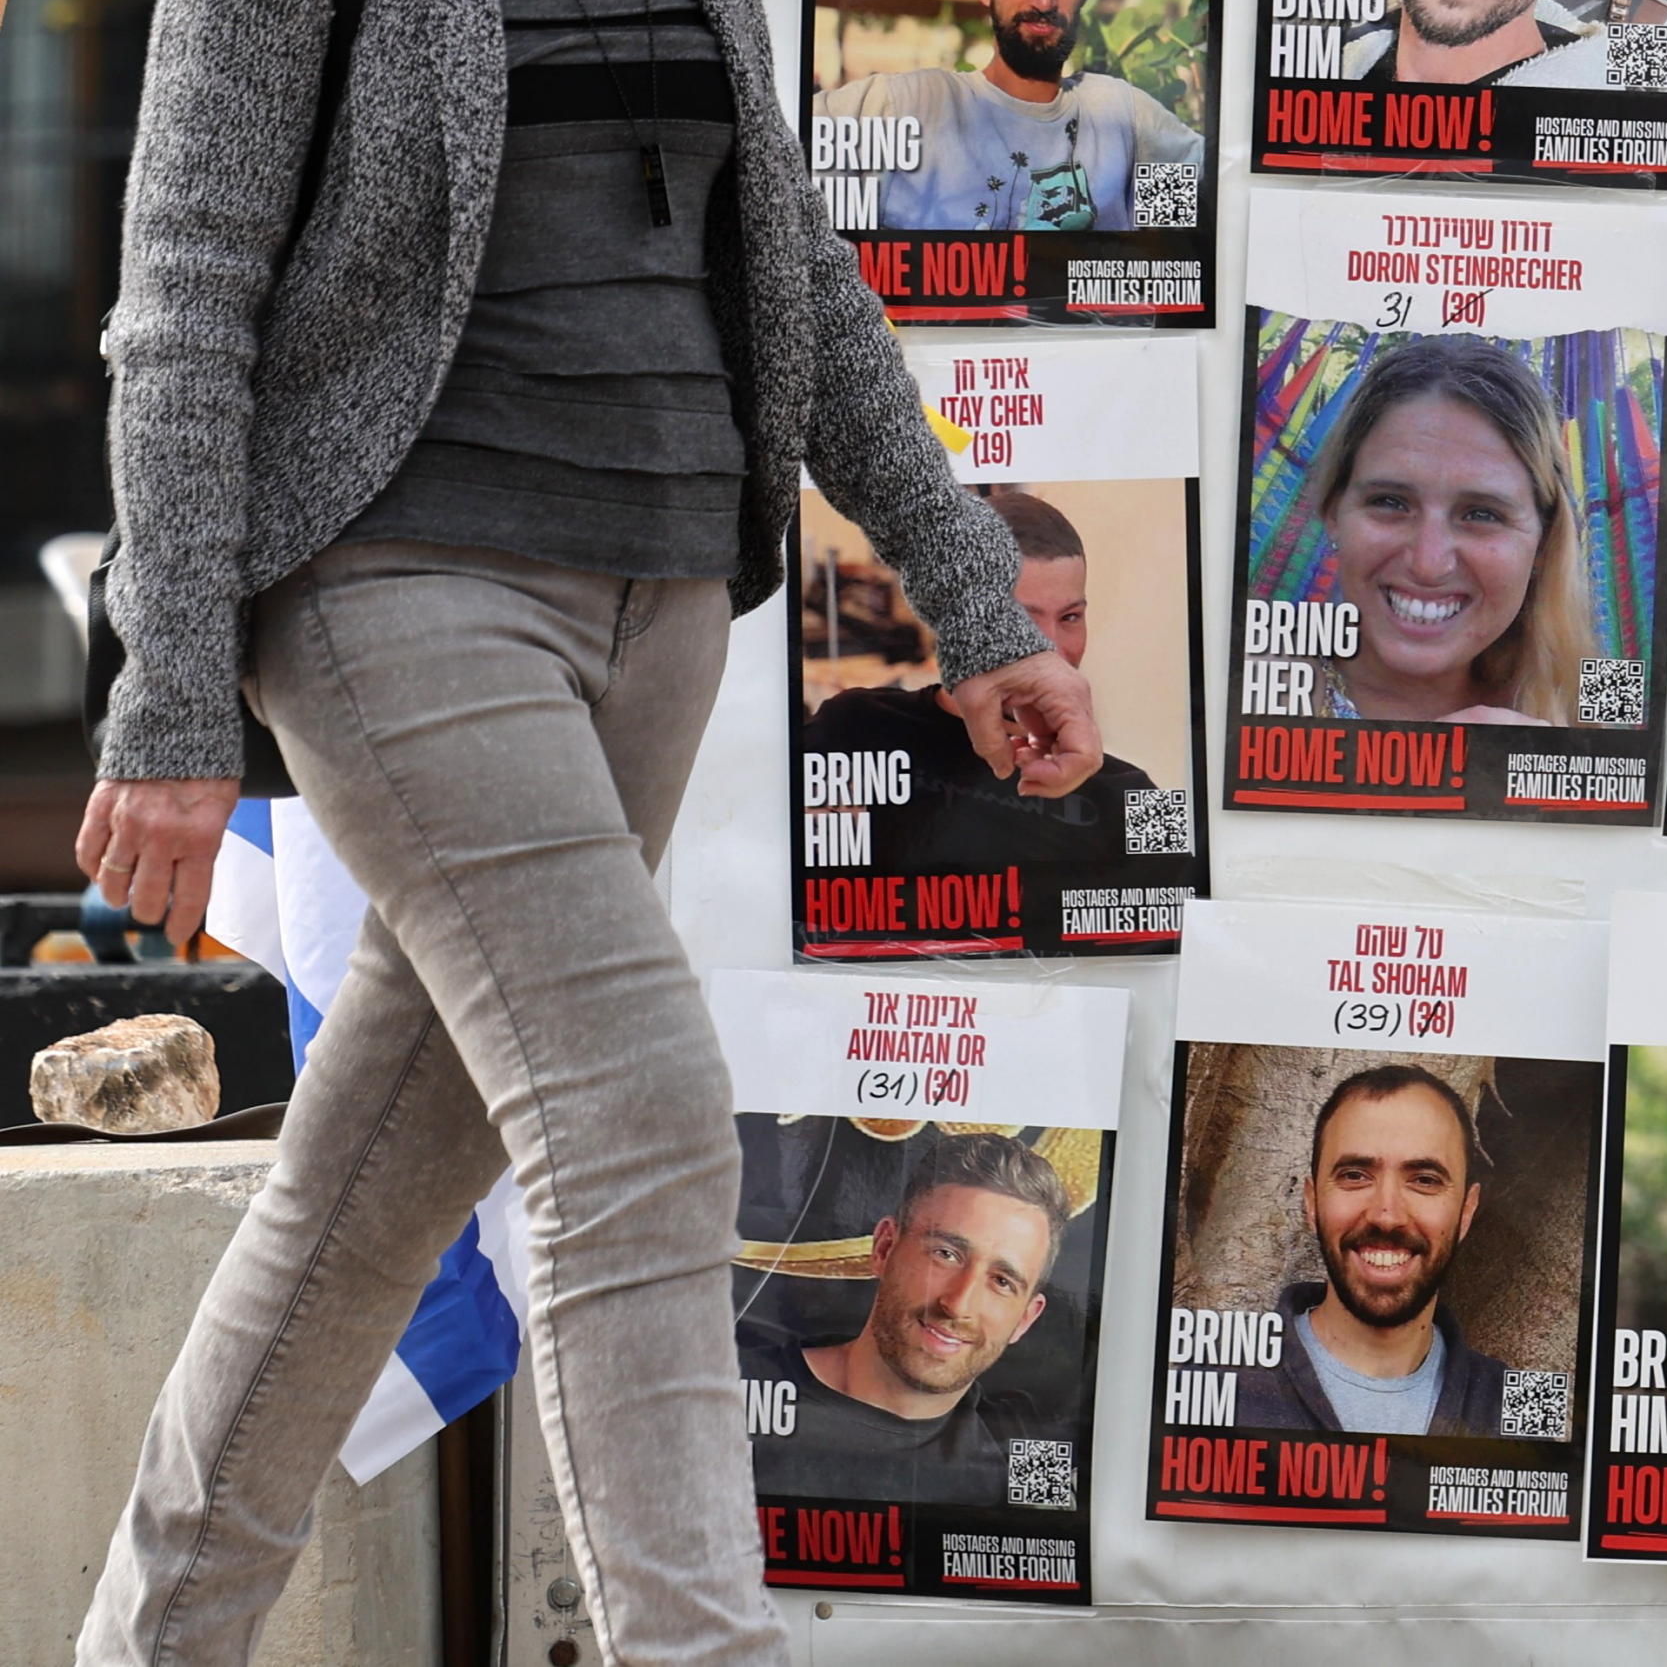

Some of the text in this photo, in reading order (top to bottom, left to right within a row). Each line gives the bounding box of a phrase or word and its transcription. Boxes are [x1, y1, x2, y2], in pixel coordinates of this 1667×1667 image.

[1347, 250, 1584, 290] DORON STEINBRECHER
[990, 394, 1045, 427] CHEN
[1355, 924, 1444, 960] טל שהם
[1328, 960, 1468, 998] TAL SHOHAM
[847, 1029, 987, 1065] AVINATAN OR
[1169, 1309, 1283, 1367] BRING
[1165, 1370, 1237, 1427] HIM
[1161, 1437, 1387, 1501] HOME NOW!
[1430, 1466, 1568, 1490] HOSTAGES AND MISSING
[1428, 1485, 1567, 1517] FAMILIES FORUM
